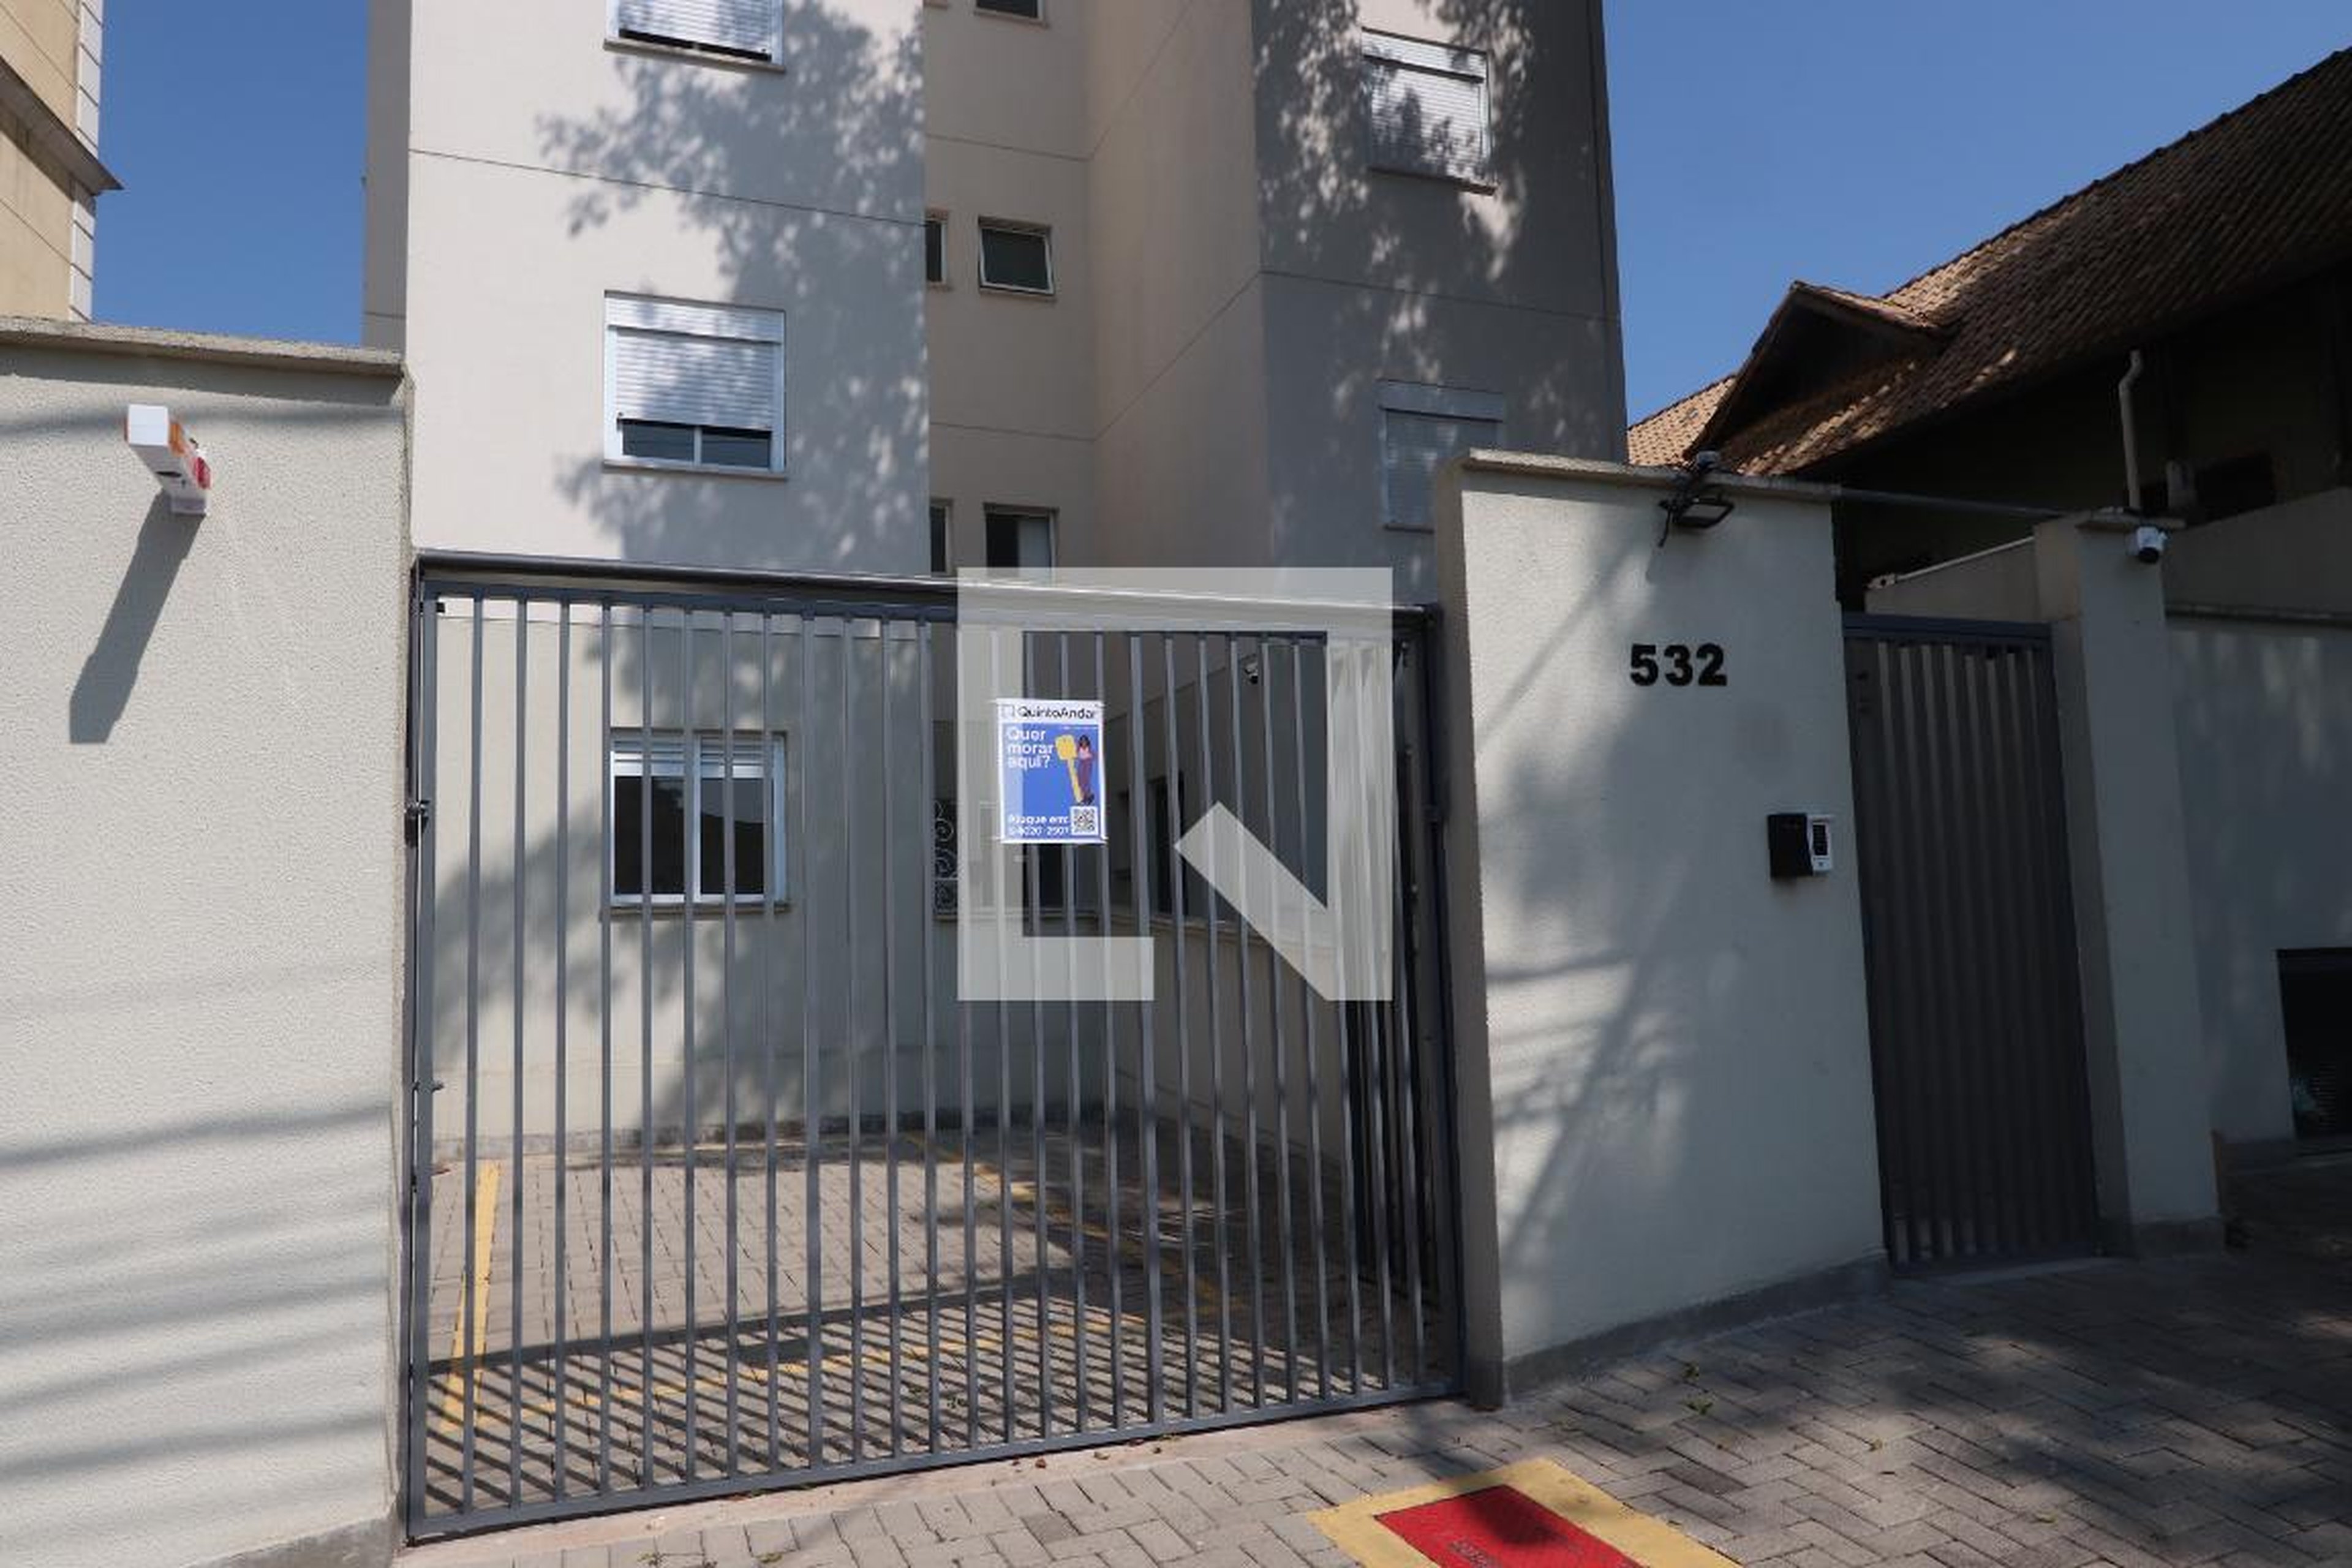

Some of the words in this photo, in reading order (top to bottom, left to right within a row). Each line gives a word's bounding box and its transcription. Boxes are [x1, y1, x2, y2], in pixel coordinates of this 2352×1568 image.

[1630, 643, 1727, 687] 532
[1017, 706, 1095, 719] QuintoAndar
[1008, 726, 1046, 741] Quer
[1008, 743, 1054, 755] morar
[1008, 755, 1050, 771] aqui?
